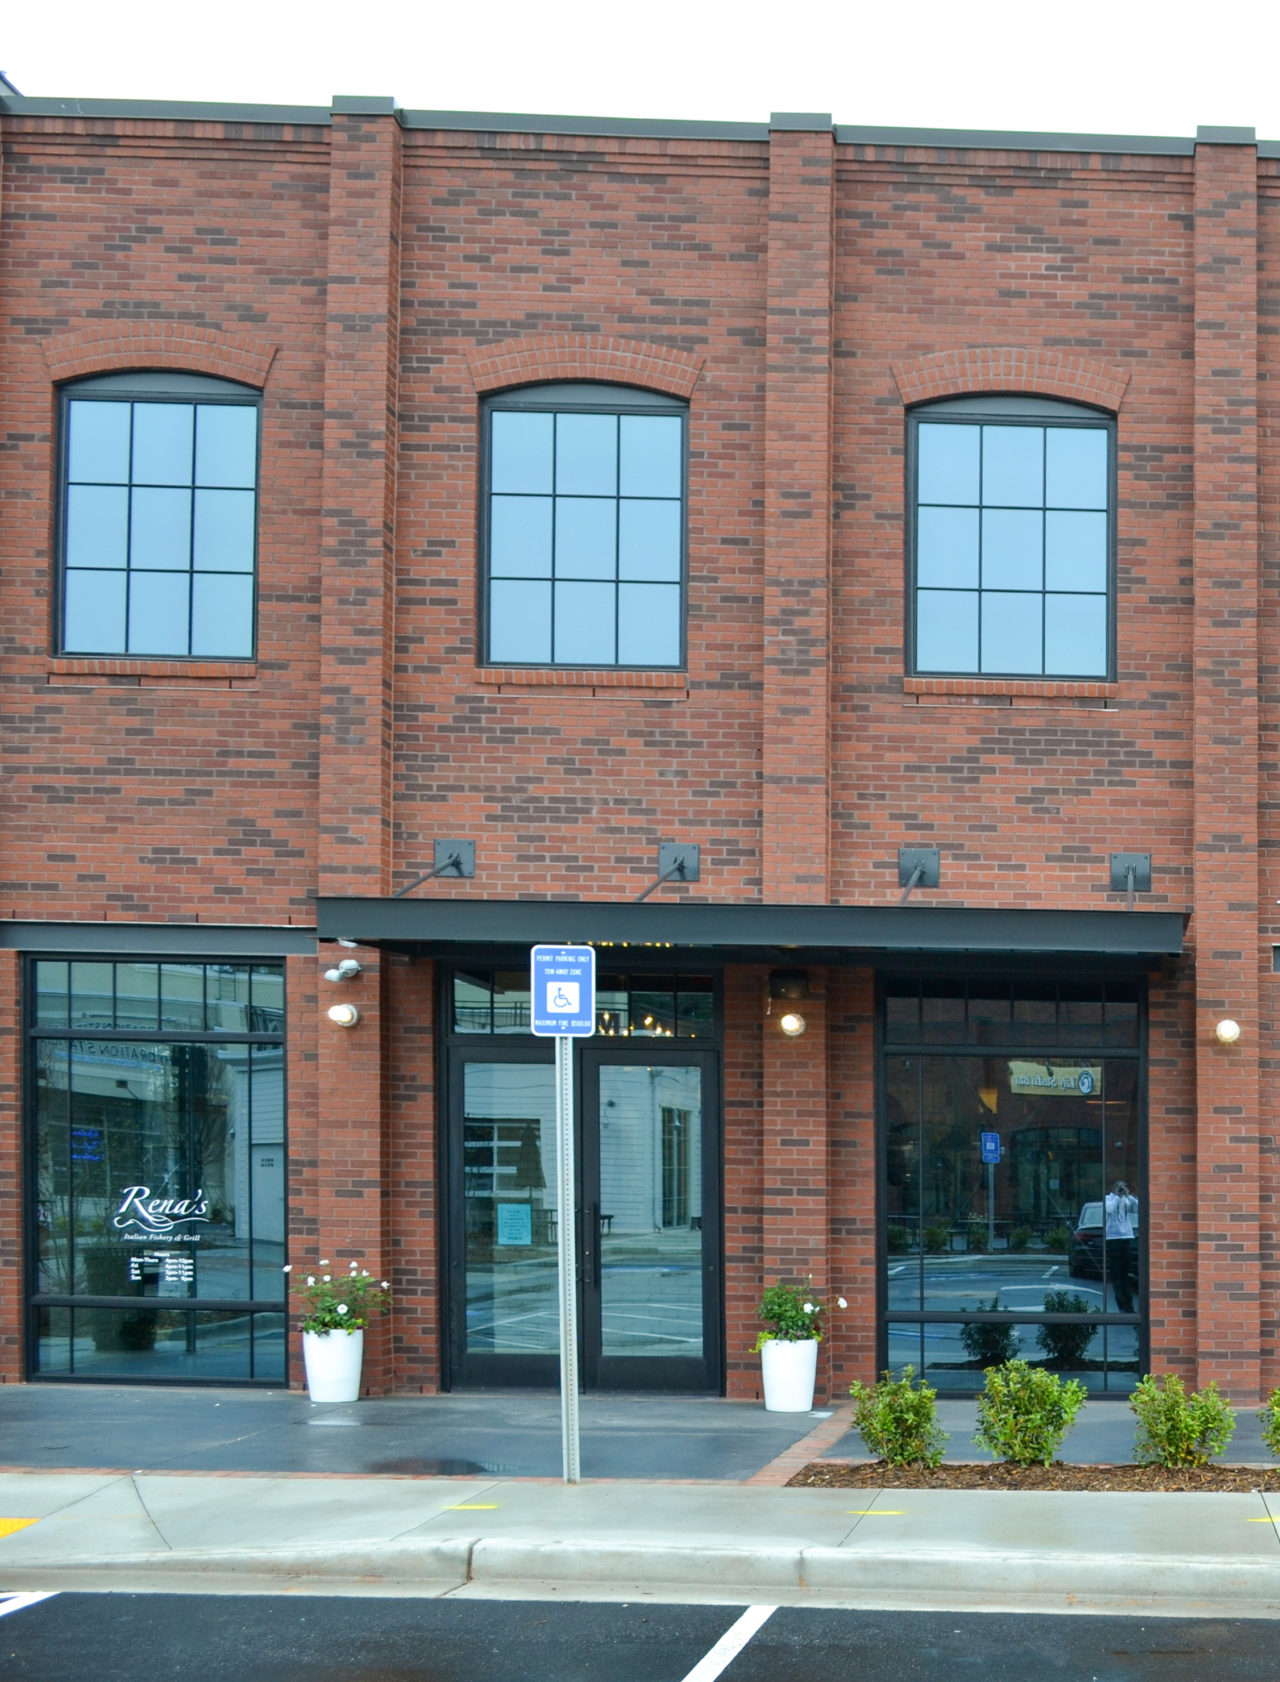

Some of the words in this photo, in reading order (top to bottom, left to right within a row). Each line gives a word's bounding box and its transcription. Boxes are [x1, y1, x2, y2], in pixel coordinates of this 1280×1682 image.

[555, 955, 576, 963] PARKING
[118, 1185, 209, 1222] Rena's
[149, 1233, 174, 1242] Fishery
[174, 1233, 183, 1242] &
[183, 1234, 201, 1242] Grill
